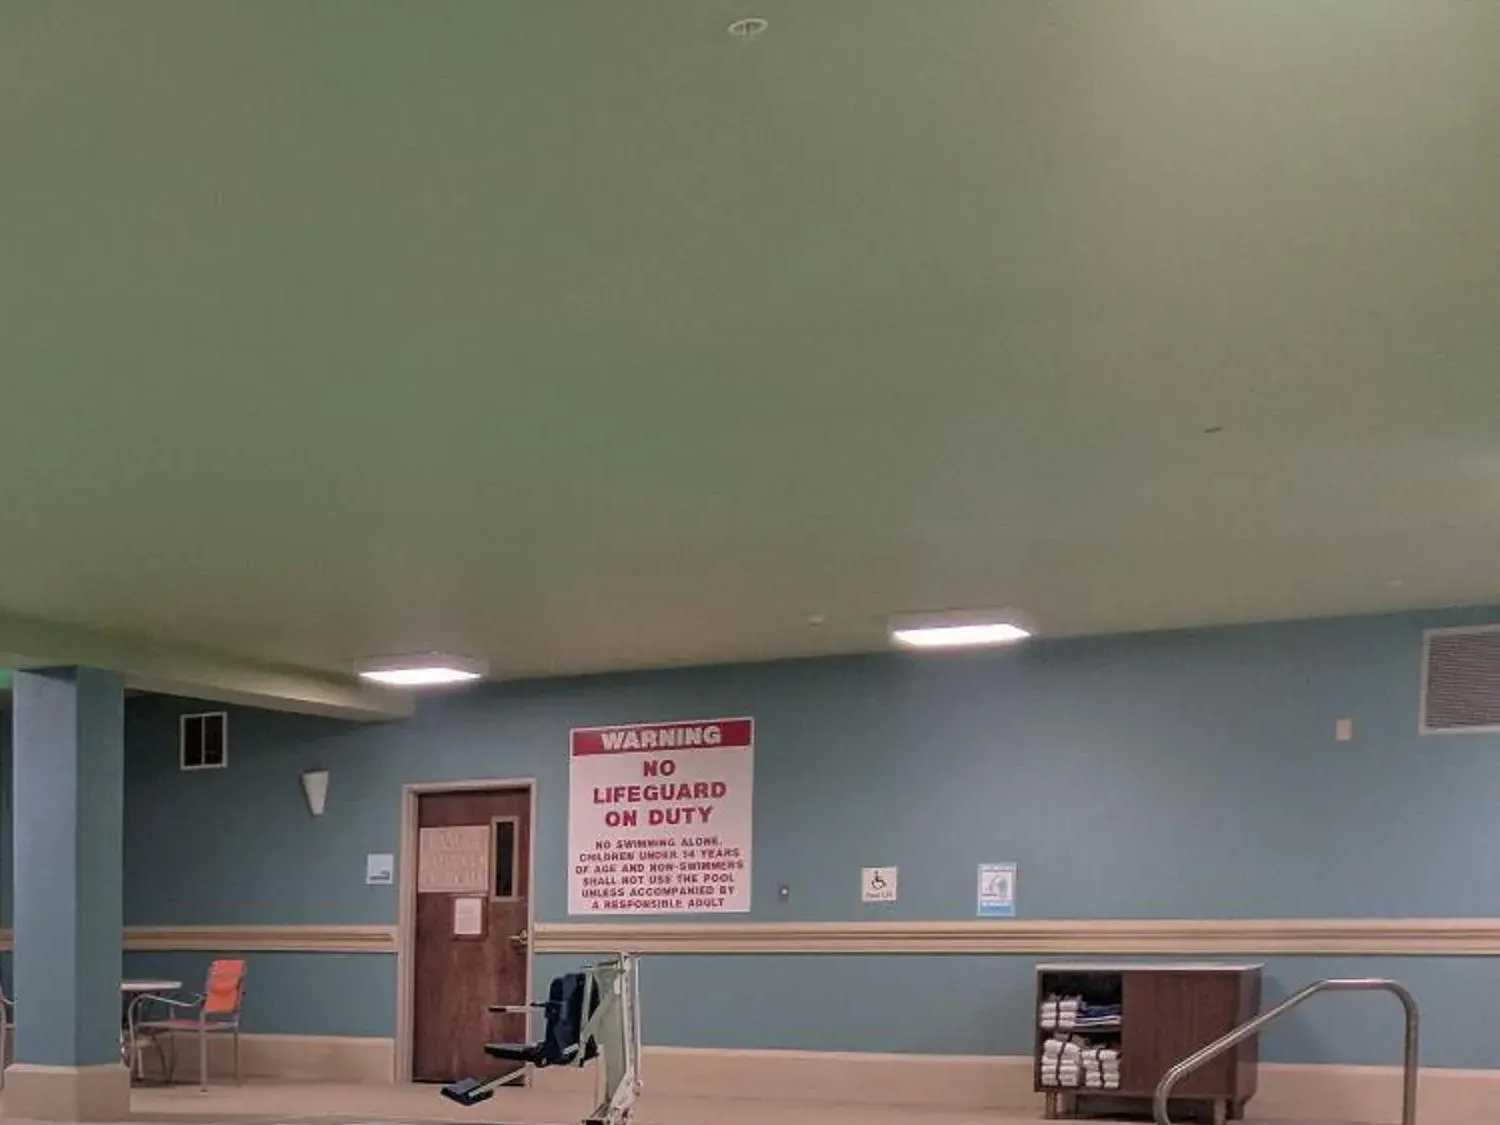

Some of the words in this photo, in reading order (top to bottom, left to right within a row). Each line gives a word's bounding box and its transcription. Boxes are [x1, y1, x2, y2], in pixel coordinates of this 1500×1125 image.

[601, 725, 722, 750] WARNING
[643, 760, 676, 776] NO
[593, 782, 727, 804] LIFEGUARD
[605, 810, 637, 827] ON
[648, 806, 713, 825] DUTY
[595, 840, 611, 849] NO
[616, 838, 676, 849] SWIMMING
[580, 852, 634, 862] CHILDREN
[575, 865, 588, 874] OF
[621, 863, 645, 872] AND
[583, 876, 616, 886] SHALL
[621, 875, 644, 884] NOT
[677, 873, 698, 883] THE
[703, 873, 734, 883] POOL
[582, 887, 625, 898] UNLESS
[629, 885, 714, 897] ACCOMPANIED
